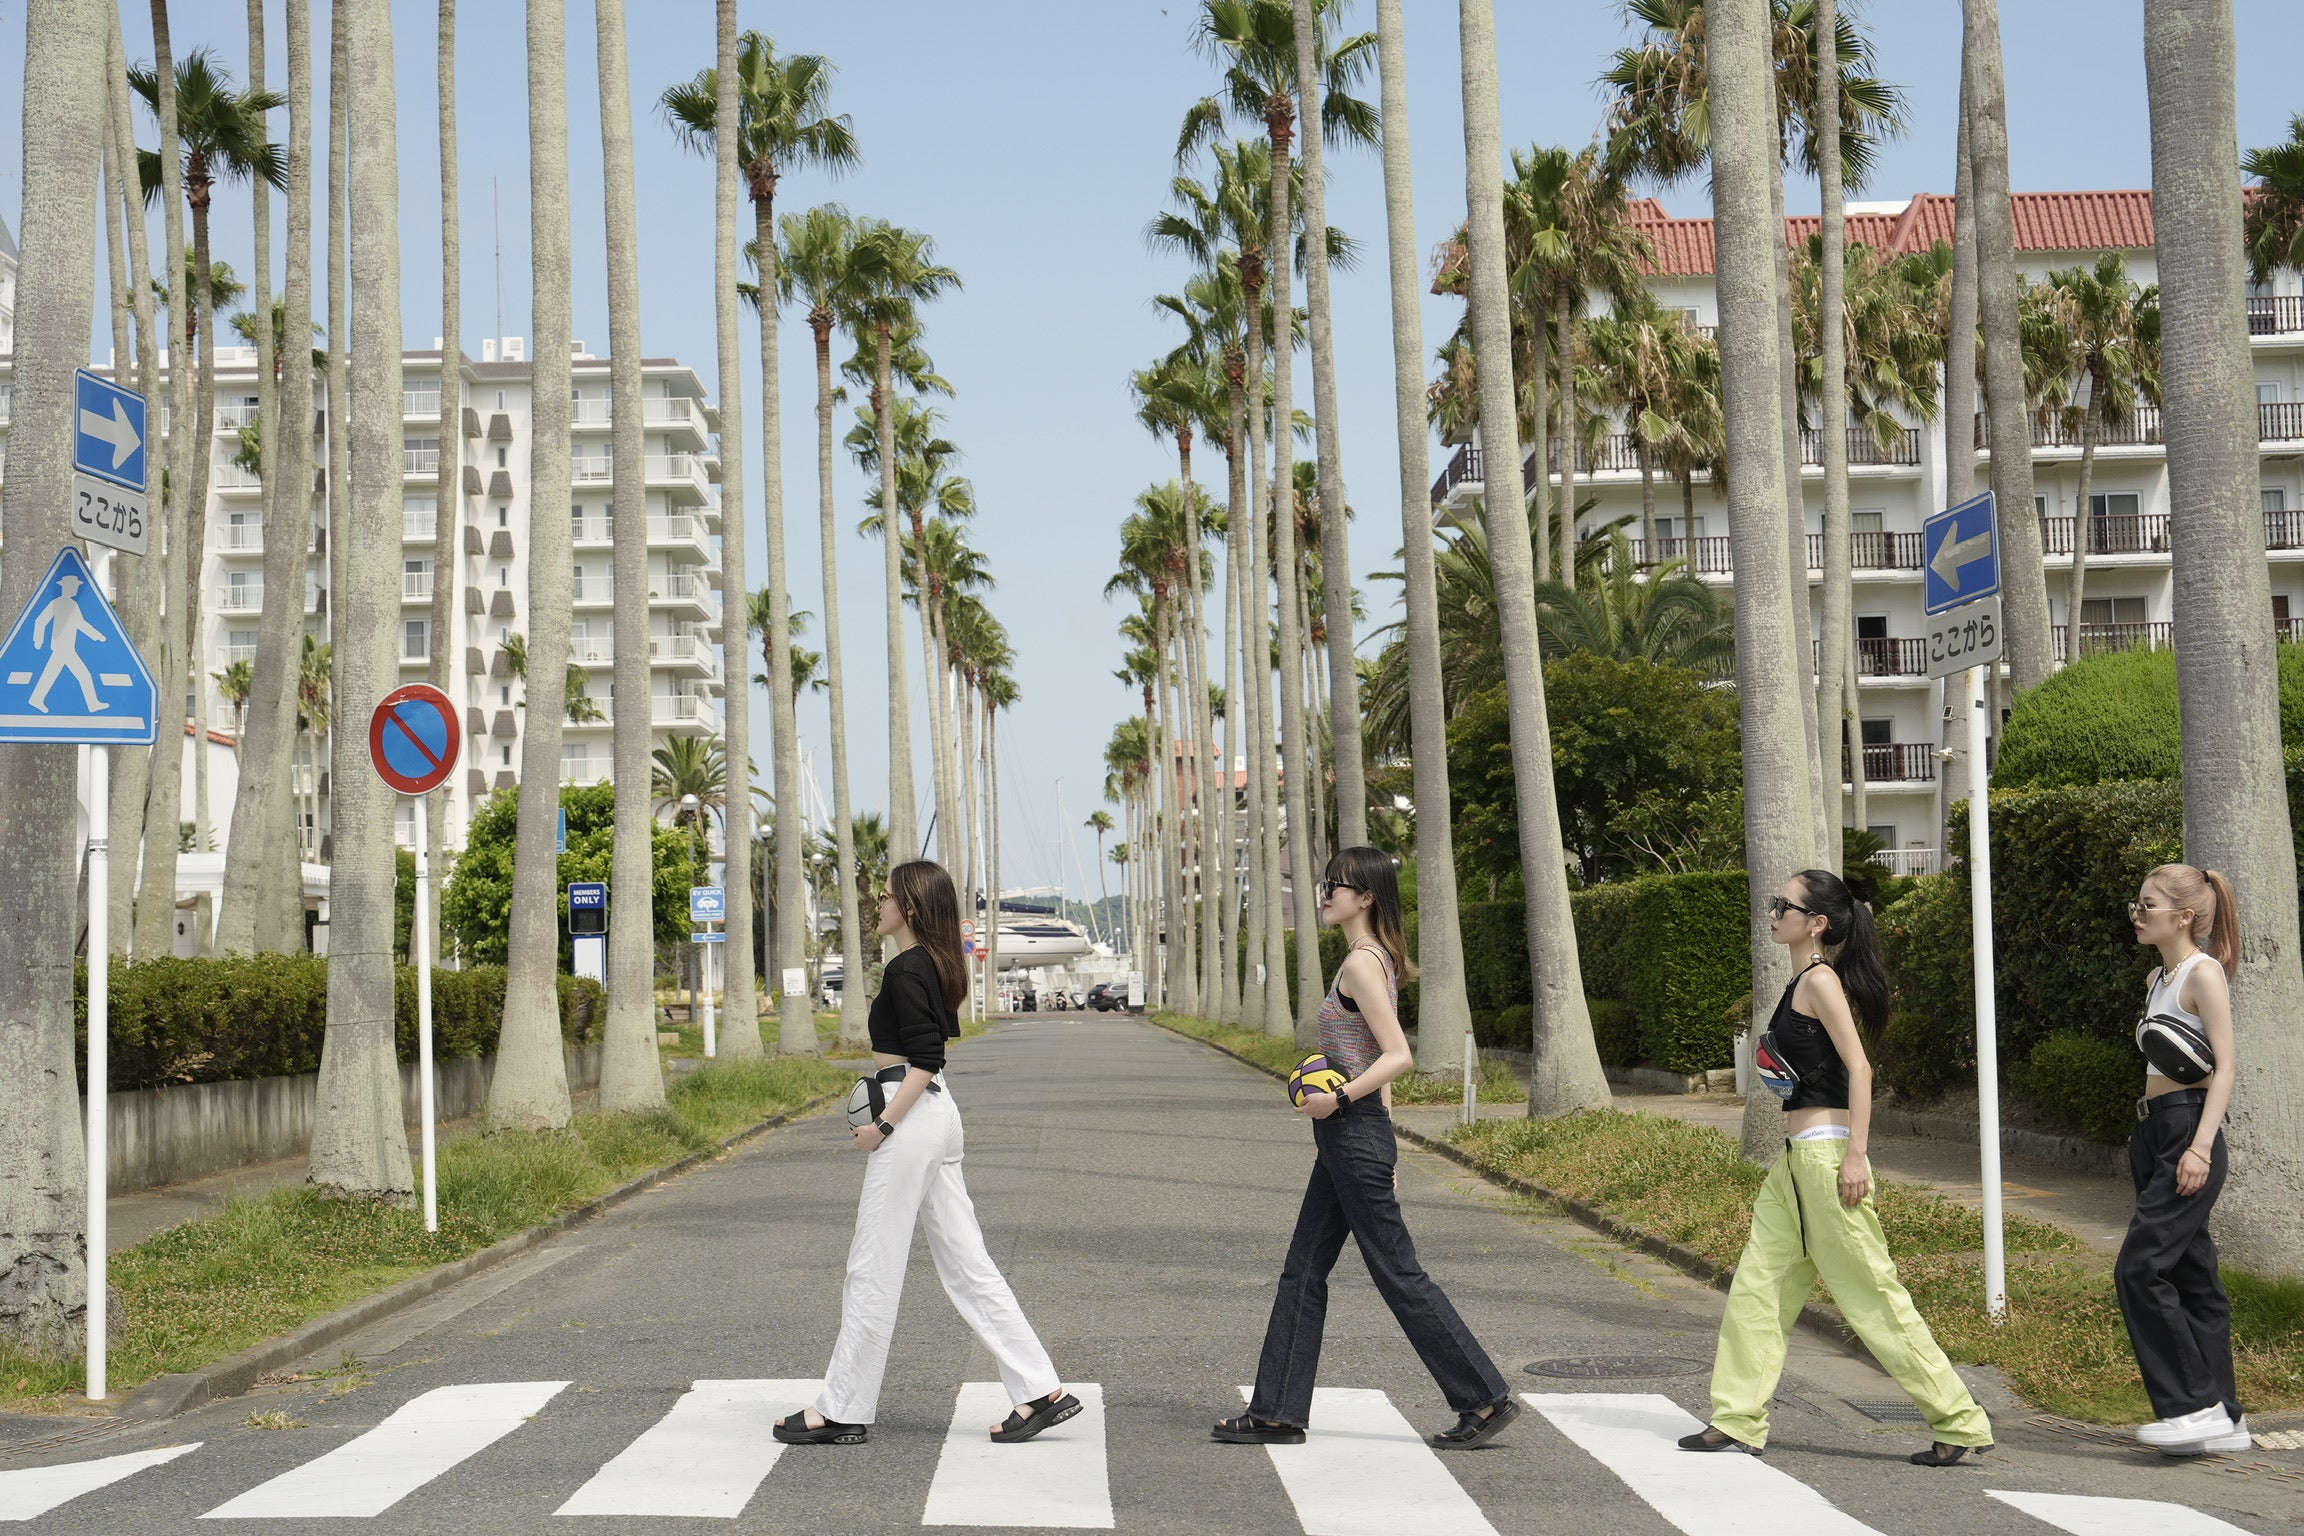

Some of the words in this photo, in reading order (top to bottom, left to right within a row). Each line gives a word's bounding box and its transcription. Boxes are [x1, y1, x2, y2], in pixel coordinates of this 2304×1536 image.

[79, 491, 142, 539] ここから
[1931, 615, 1995, 662] ここから
[573, 896, 600, 904] ONLY
